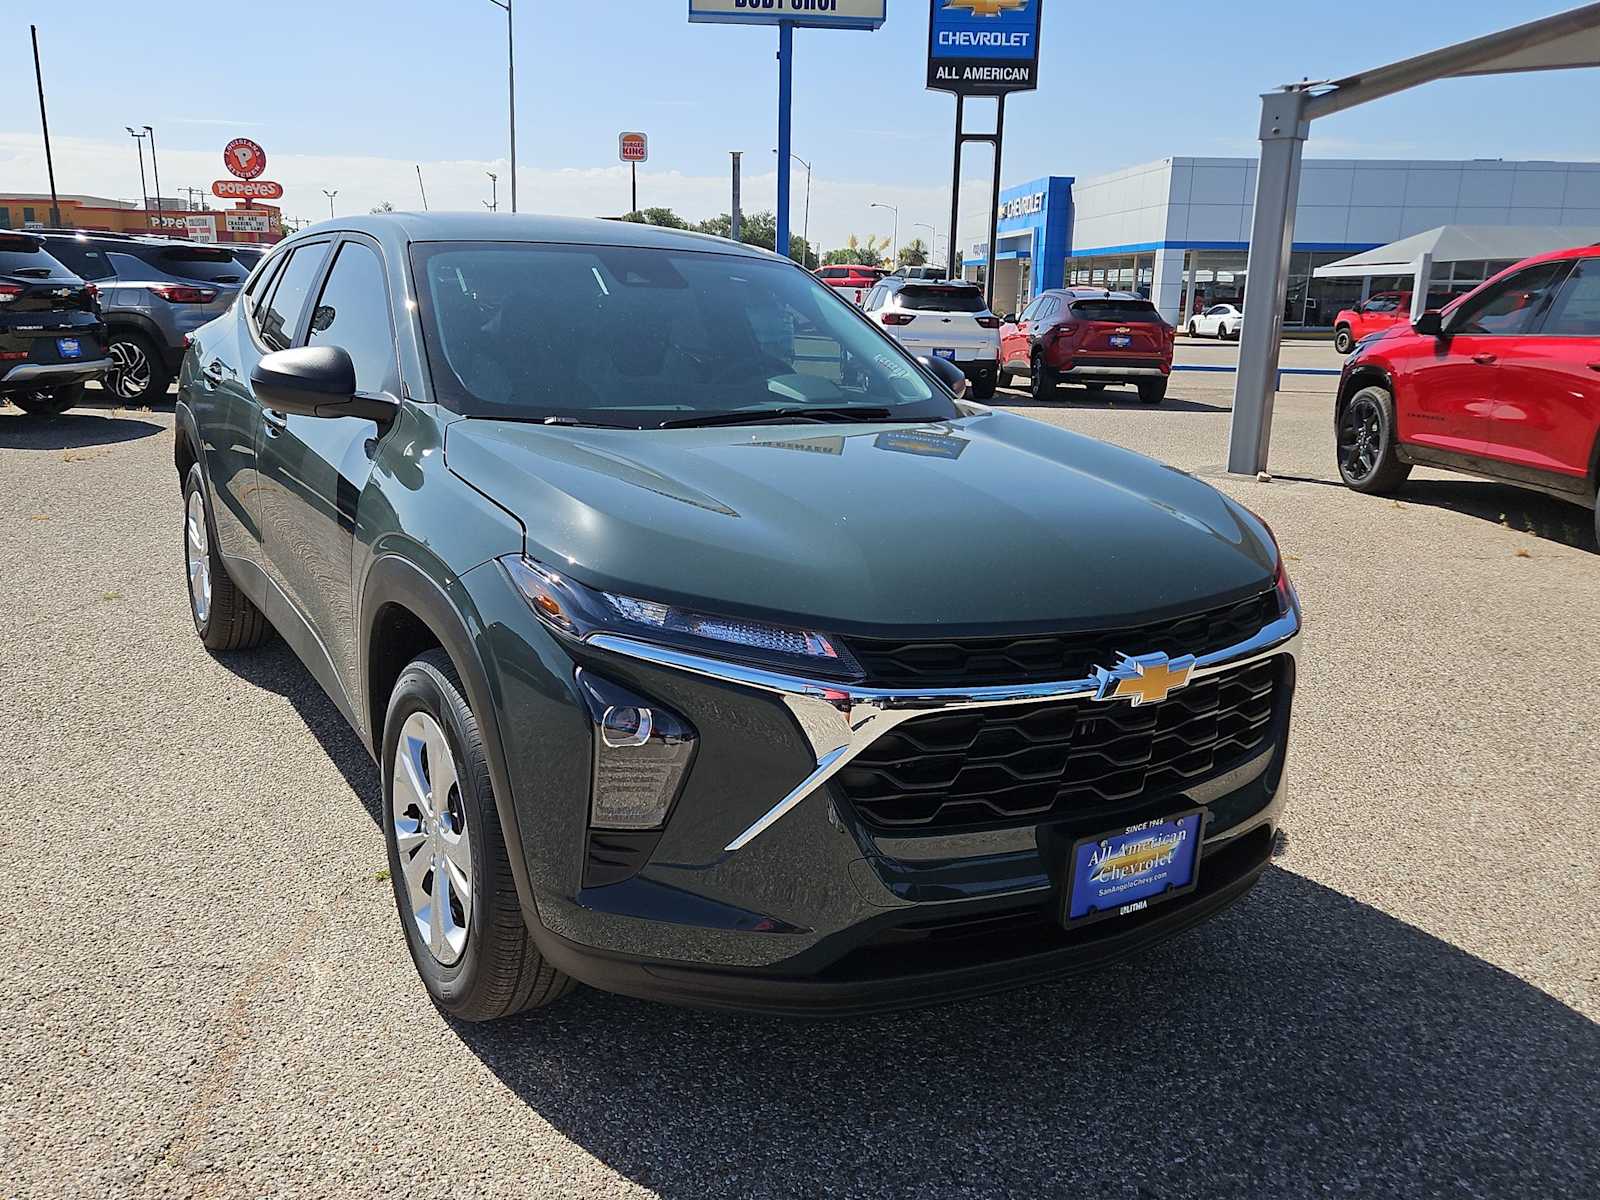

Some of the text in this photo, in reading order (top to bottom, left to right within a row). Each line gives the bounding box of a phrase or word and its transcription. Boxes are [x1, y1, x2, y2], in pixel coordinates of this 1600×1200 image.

[938, 31, 1030, 47] CHEVROLET
[936, 66, 1029, 81] ALL AMERICAN
[623, 147, 645, 156] KING
[1007, 192, 1044, 218] CHEVROLET
[1125, 820, 1148, 835] SINCE
[1088, 829, 1186, 867] All American
[1099, 850, 1173, 883] Chevrolet
[1098, 871, 1168, 897] SanAngeloChevy.com
